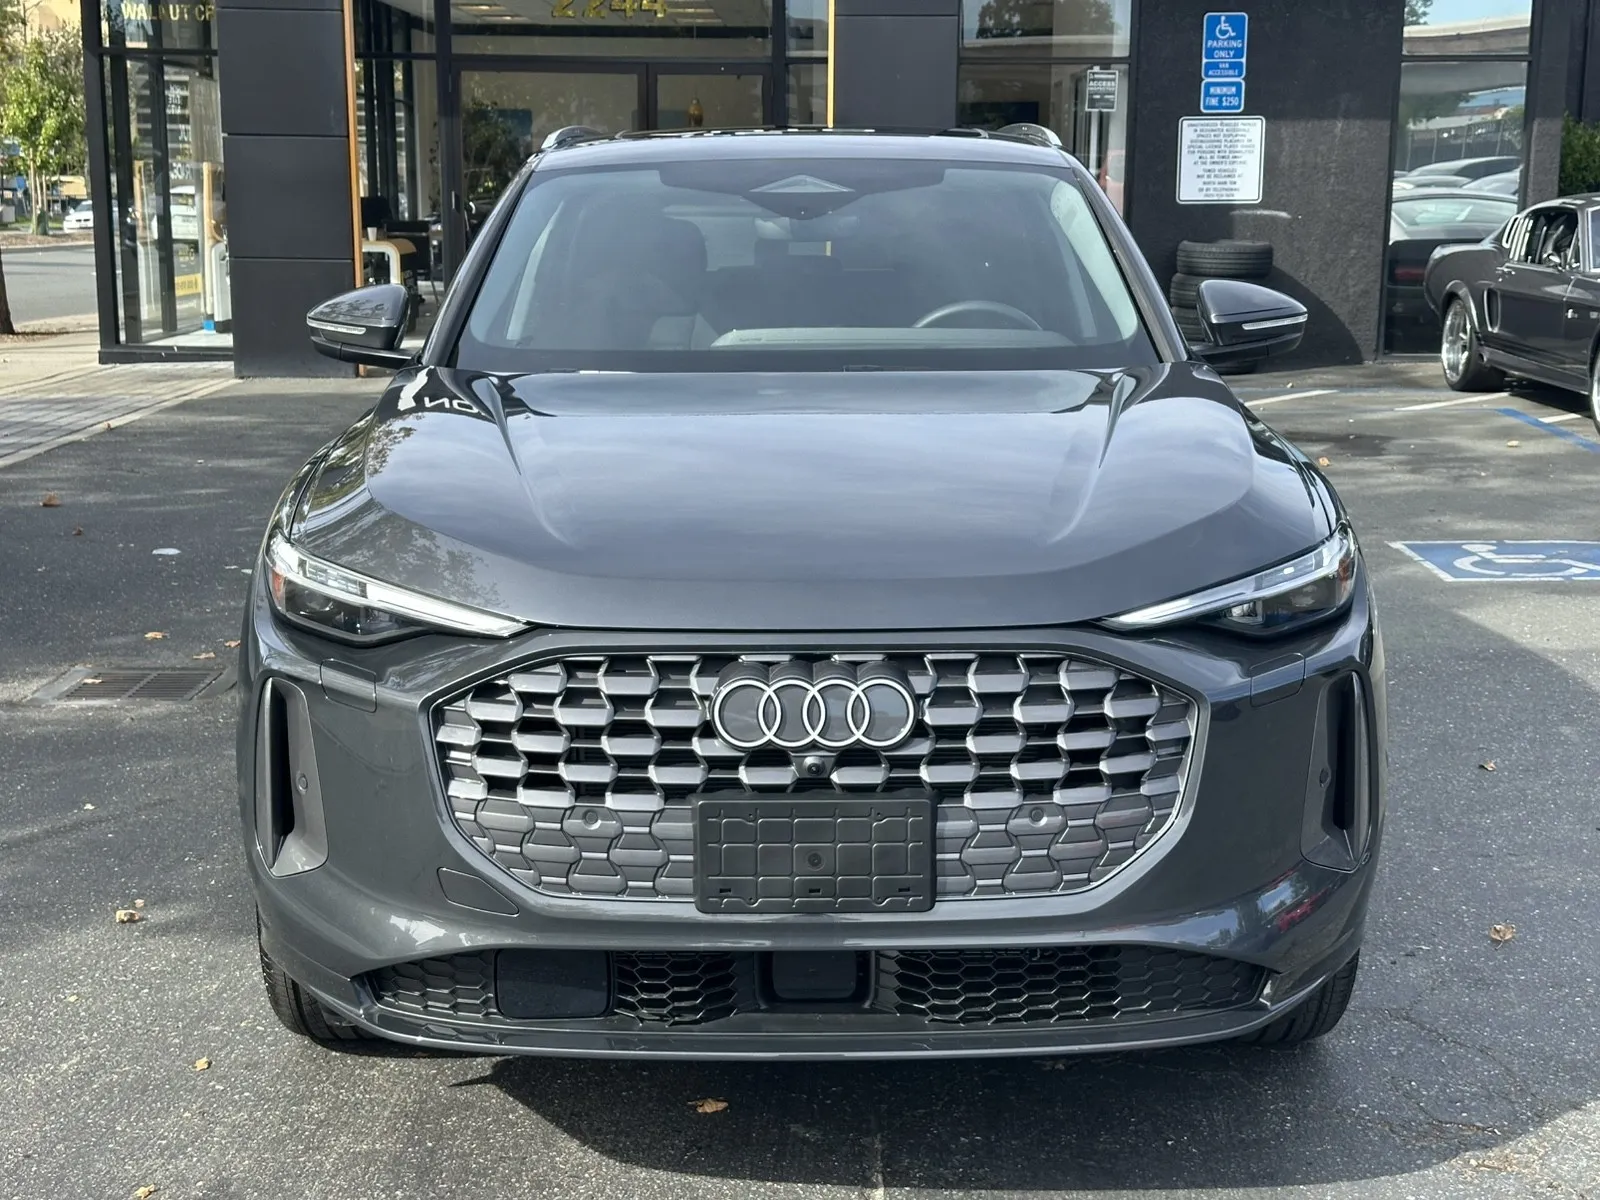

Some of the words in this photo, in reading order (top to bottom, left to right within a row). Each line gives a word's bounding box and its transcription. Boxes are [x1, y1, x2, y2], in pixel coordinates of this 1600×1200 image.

[1207, 39, 1242, 48] PARKING
[1213, 50, 1235, 58] ONLY
[1209, 86, 1237, 95] MINIMUM
[1205, 97, 1219, 106] FINE
[1222, 96, 1239, 107] $250
